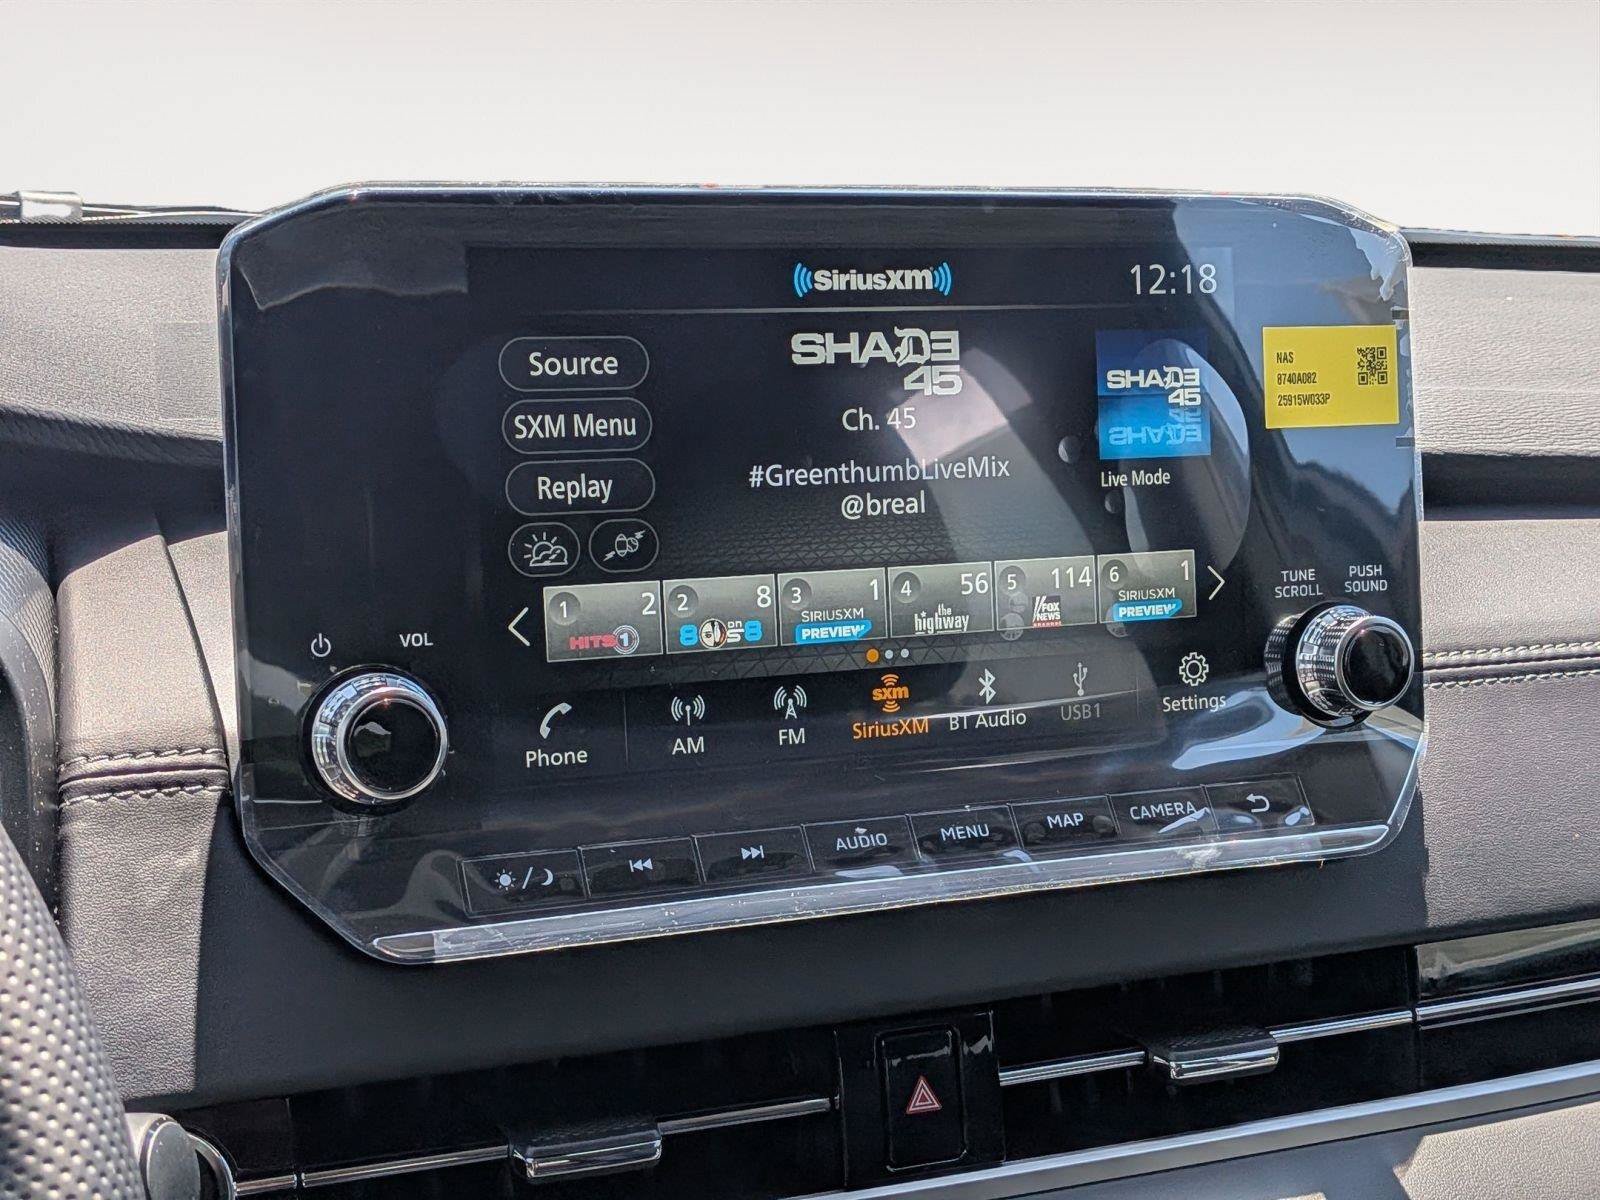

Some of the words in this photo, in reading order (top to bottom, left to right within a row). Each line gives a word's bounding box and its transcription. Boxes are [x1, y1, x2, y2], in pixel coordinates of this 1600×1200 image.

[1129, 263, 1218, 295] 12:18
[528, 352, 619, 376] Source
[1276, 351, 1294, 364] NAS
[903, 365, 963, 396] 45
[1276, 372, 1318, 385] 8740A082
[1168, 388, 1201, 406] 45
[1277, 393, 1331, 407] 25915W033P
[513, 414, 566, 439] SXM
[573, 413, 637, 438] Menu
[842, 407, 880, 431] Ch.
[886, 407, 917, 430] 45
[748, 455, 1011, 488] #GreenthumbLiveMix
[1100, 471, 1129, 488] Live
[1131, 468, 1171, 486] Mode
[537, 473, 613, 504] Replay
[840, 489, 926, 520] @breal
[1051, 565, 1093, 589] 114
[1109, 566, 1120, 583] 6
[1180, 560, 1190, 581] 1
[1280, 568, 1317, 582] TUNE
[1349, 564, 1383, 577] PUSH
[869, 579, 879, 601] 1
[900, 580, 912, 597] 4
[960, 572, 989, 595] 56
[1006, 574, 1017, 590] 5
[1274, 583, 1324, 598] SCROLL
[1344, 579, 1388, 593] SOUND
[676, 593, 689, 611] 2
[756, 585, 772, 608] 8
[791, 587, 802, 604] 3
[1118, 586, 1176, 602] SIRIUSXM
[559, 601, 568, 618] 1
[641, 592, 657, 616] 2
[936, 603, 953, 616] the
[1041, 601, 1060, 612] FOX
[1118, 602, 1176, 618] PREVIEW
[801, 607, 865, 623] SIRIUSXM
[914, 611, 970, 635] highway
[1036, 612, 1061, 621] NEWS
[399, 632, 434, 648] VOL
[744, 620, 764, 642] 8
[801, 624, 866, 640] PREVIEW
[1060, 703, 1101, 721] USB1
[1162, 694, 1227, 714] Settings
[852, 716, 930, 740] SiriusXM
[949, 715, 969, 731] BT
[975, 709, 1027, 729] Audio
[671, 736, 705, 756] AM
[778, 728, 806, 746] FM
[525, 748, 588, 768] Phone
[1129, 800, 1197, 821] CAMERA
[1047, 812, 1084, 830] MAP
[940, 822, 990, 842] MENU
[835, 832, 888, 851] AUDIO
